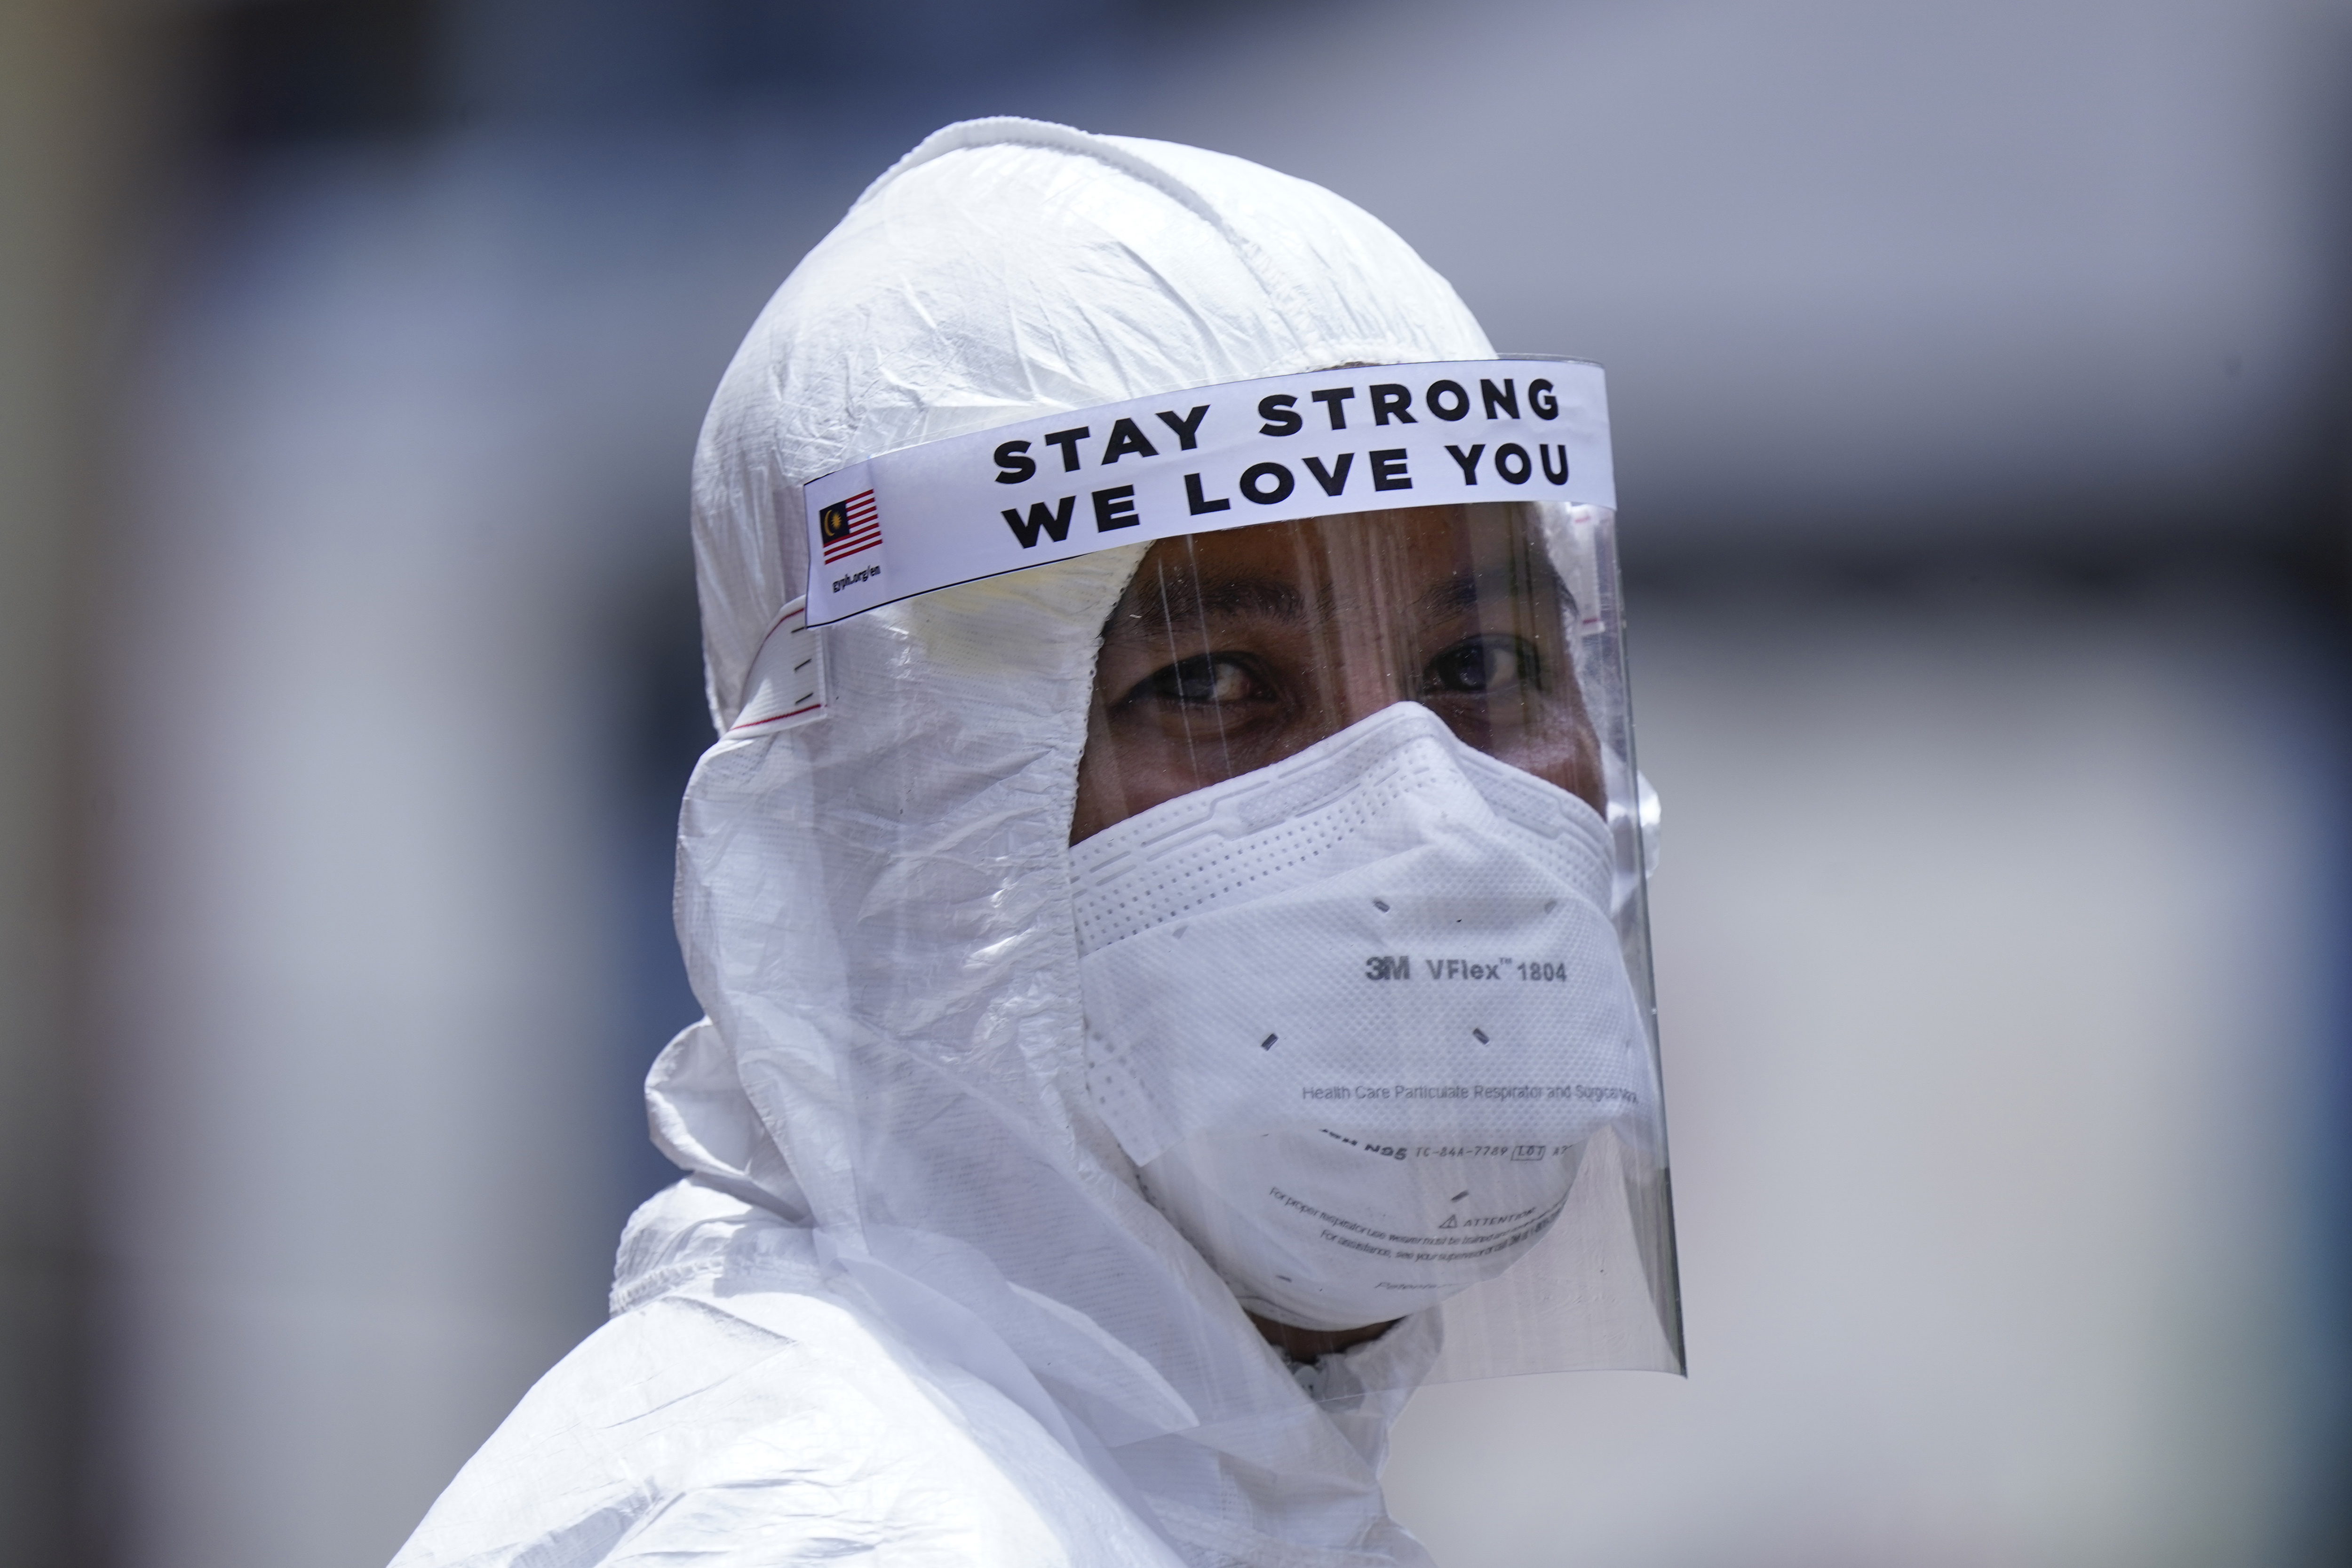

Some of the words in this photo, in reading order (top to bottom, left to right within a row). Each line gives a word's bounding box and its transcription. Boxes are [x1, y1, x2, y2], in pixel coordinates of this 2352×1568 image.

[994, 405, 1210, 484] STAY
[1258, 378, 1559, 437] STRONG
[1001, 484, 1140, 549] WE
[1184, 448, 1413, 516] LOVE
[1444, 443, 1569, 486] YOU
[1365, 955, 1411, 980] 3M
[1517, 962, 1567, 982] 1804
[1302, 1086, 1351, 1099] Health
[1355, 1085, 1391, 1099] Care
[1395, 1085, 1469, 1099] Particulate
[1473, 1085, 1543, 1101] Respirator
[1547, 1085, 1572, 1099] and
[1516, 1145, 1546, 1158] LOT
[1269, 1186, 1287, 1201] For
[1319, 1228, 1339, 1242] For
